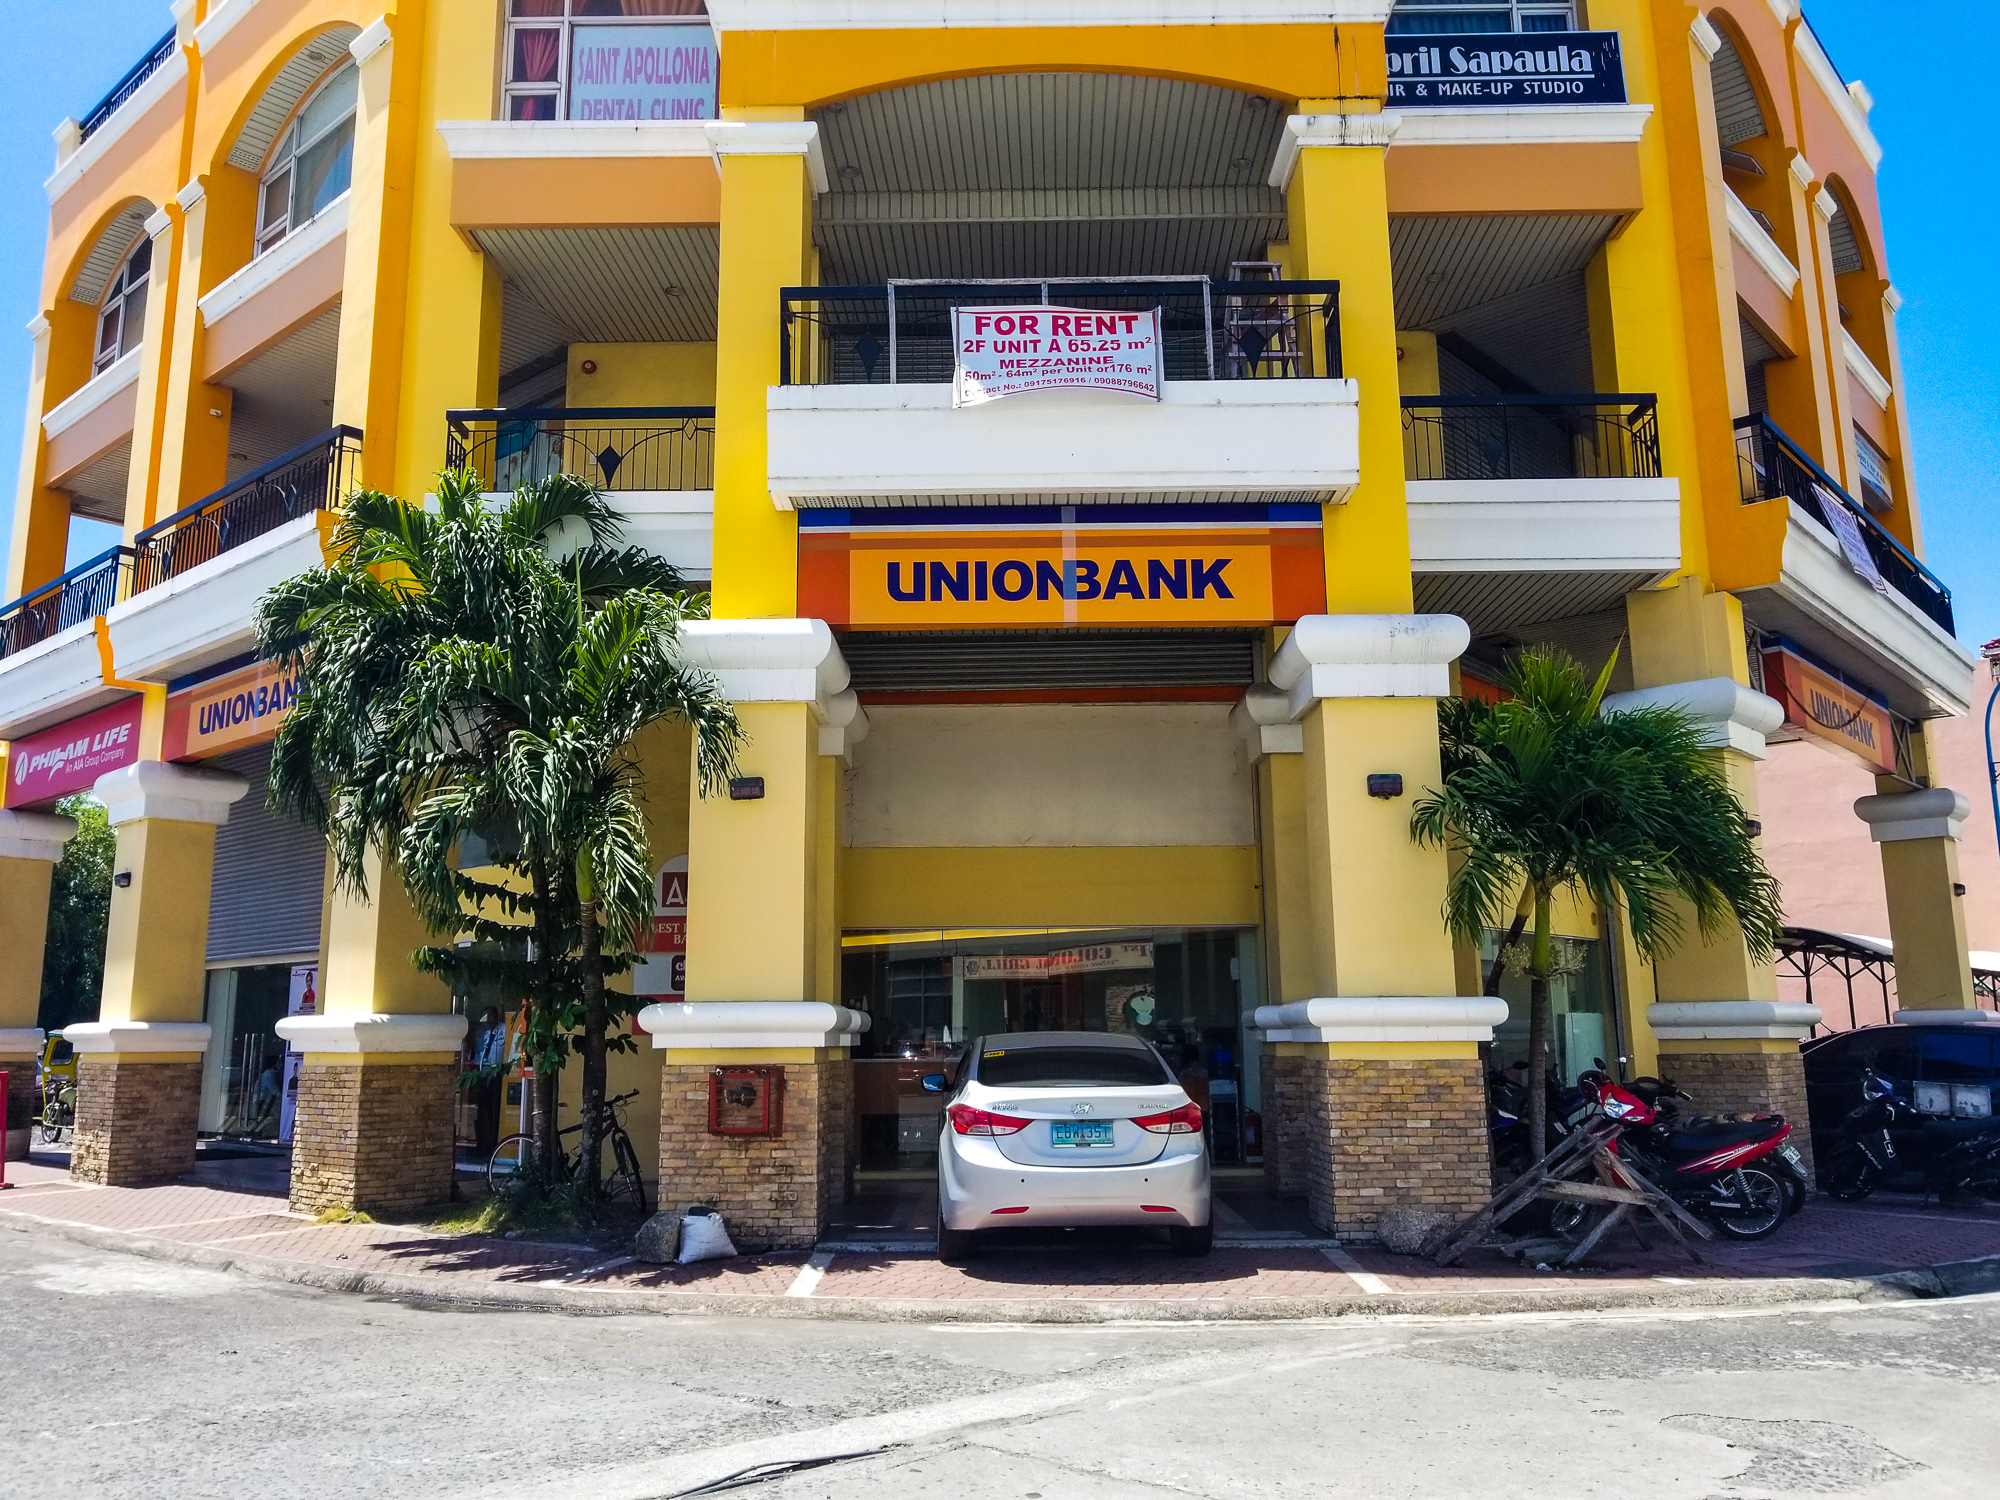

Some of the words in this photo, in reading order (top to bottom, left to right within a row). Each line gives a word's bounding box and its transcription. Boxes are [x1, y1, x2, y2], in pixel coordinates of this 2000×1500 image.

[578, 47, 620, 85] SAINT
[622, 46, 710, 84] APOLLONIA
[1386, 46, 1441, 75] pril
[1450, 46, 1593, 73] Sapaula
[1389, 84, 1406, 97] IR
[1415, 83, 1428, 96] &
[1438, 82, 1514, 96] MAKE-UP
[1524, 81, 1584, 94] STUDIO
[580, 98, 645, 120] DENTAL
[650, 98, 705, 120] CLINIC
[974, 315, 1040, 336] FOR
[1051, 315, 1139, 337] RENT
[963, 339, 986, 353] 2F
[993, 339, 1042, 353] UNIT
[1048, 338, 1062, 353] A
[1067, 338, 1121, 353] 65.25
[999, 355, 1115, 370] MEZZANINE
[1041, 368, 1062, 377] per
[964, 385, 1001, 398] Cact
[1024, 377, 1087, 388] 09175176916
[1094, 377, 1155, 392] 09088796642
[886, 558, 1236, 603] UNIONBANK
[198, 676, 305, 736] UNIONBAN
[29, 737, 90, 780] PHILAM
[91, 722, 132, 752] LIFE
[65, 762, 73, 774] An
[72, 759, 84, 772] AIA
[84, 756, 100, 768] Group
[100, 748, 125, 763] Company
[1056, 1125, 1080, 1139] EBW
